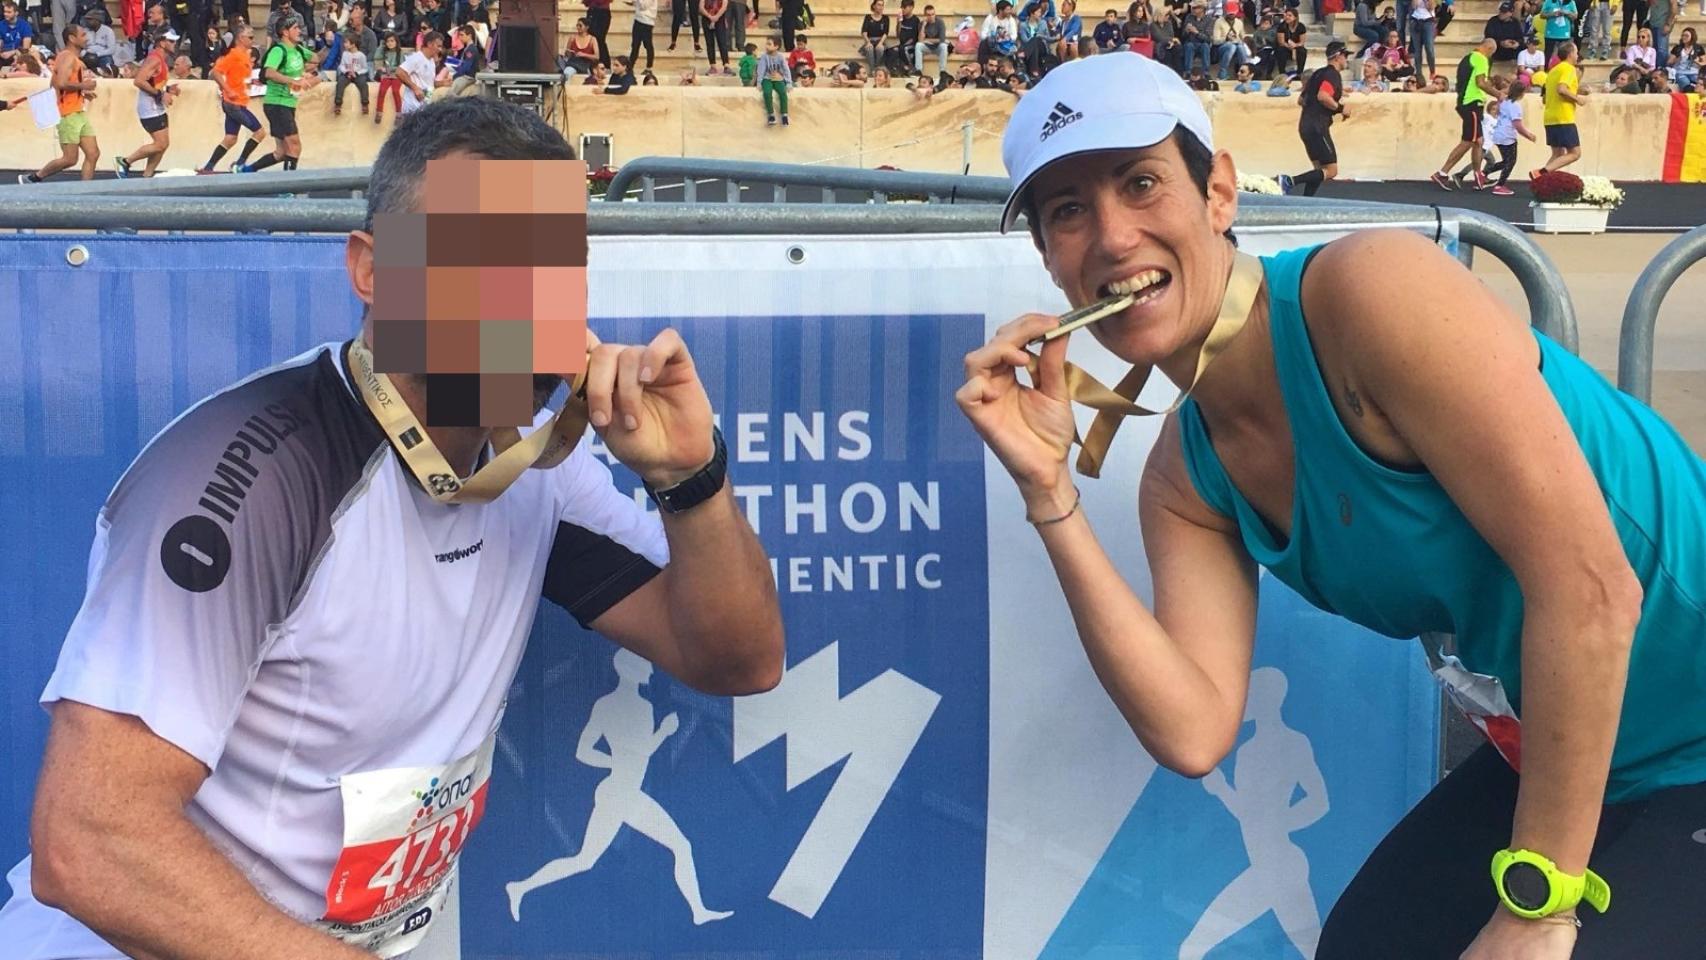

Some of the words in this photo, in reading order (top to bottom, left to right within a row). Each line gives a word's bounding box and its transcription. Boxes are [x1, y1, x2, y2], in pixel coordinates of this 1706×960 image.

[1040, 111, 1084, 142] adidas
[634, 481, 940, 534] THON
[771, 553, 942, 593] ENTIC
